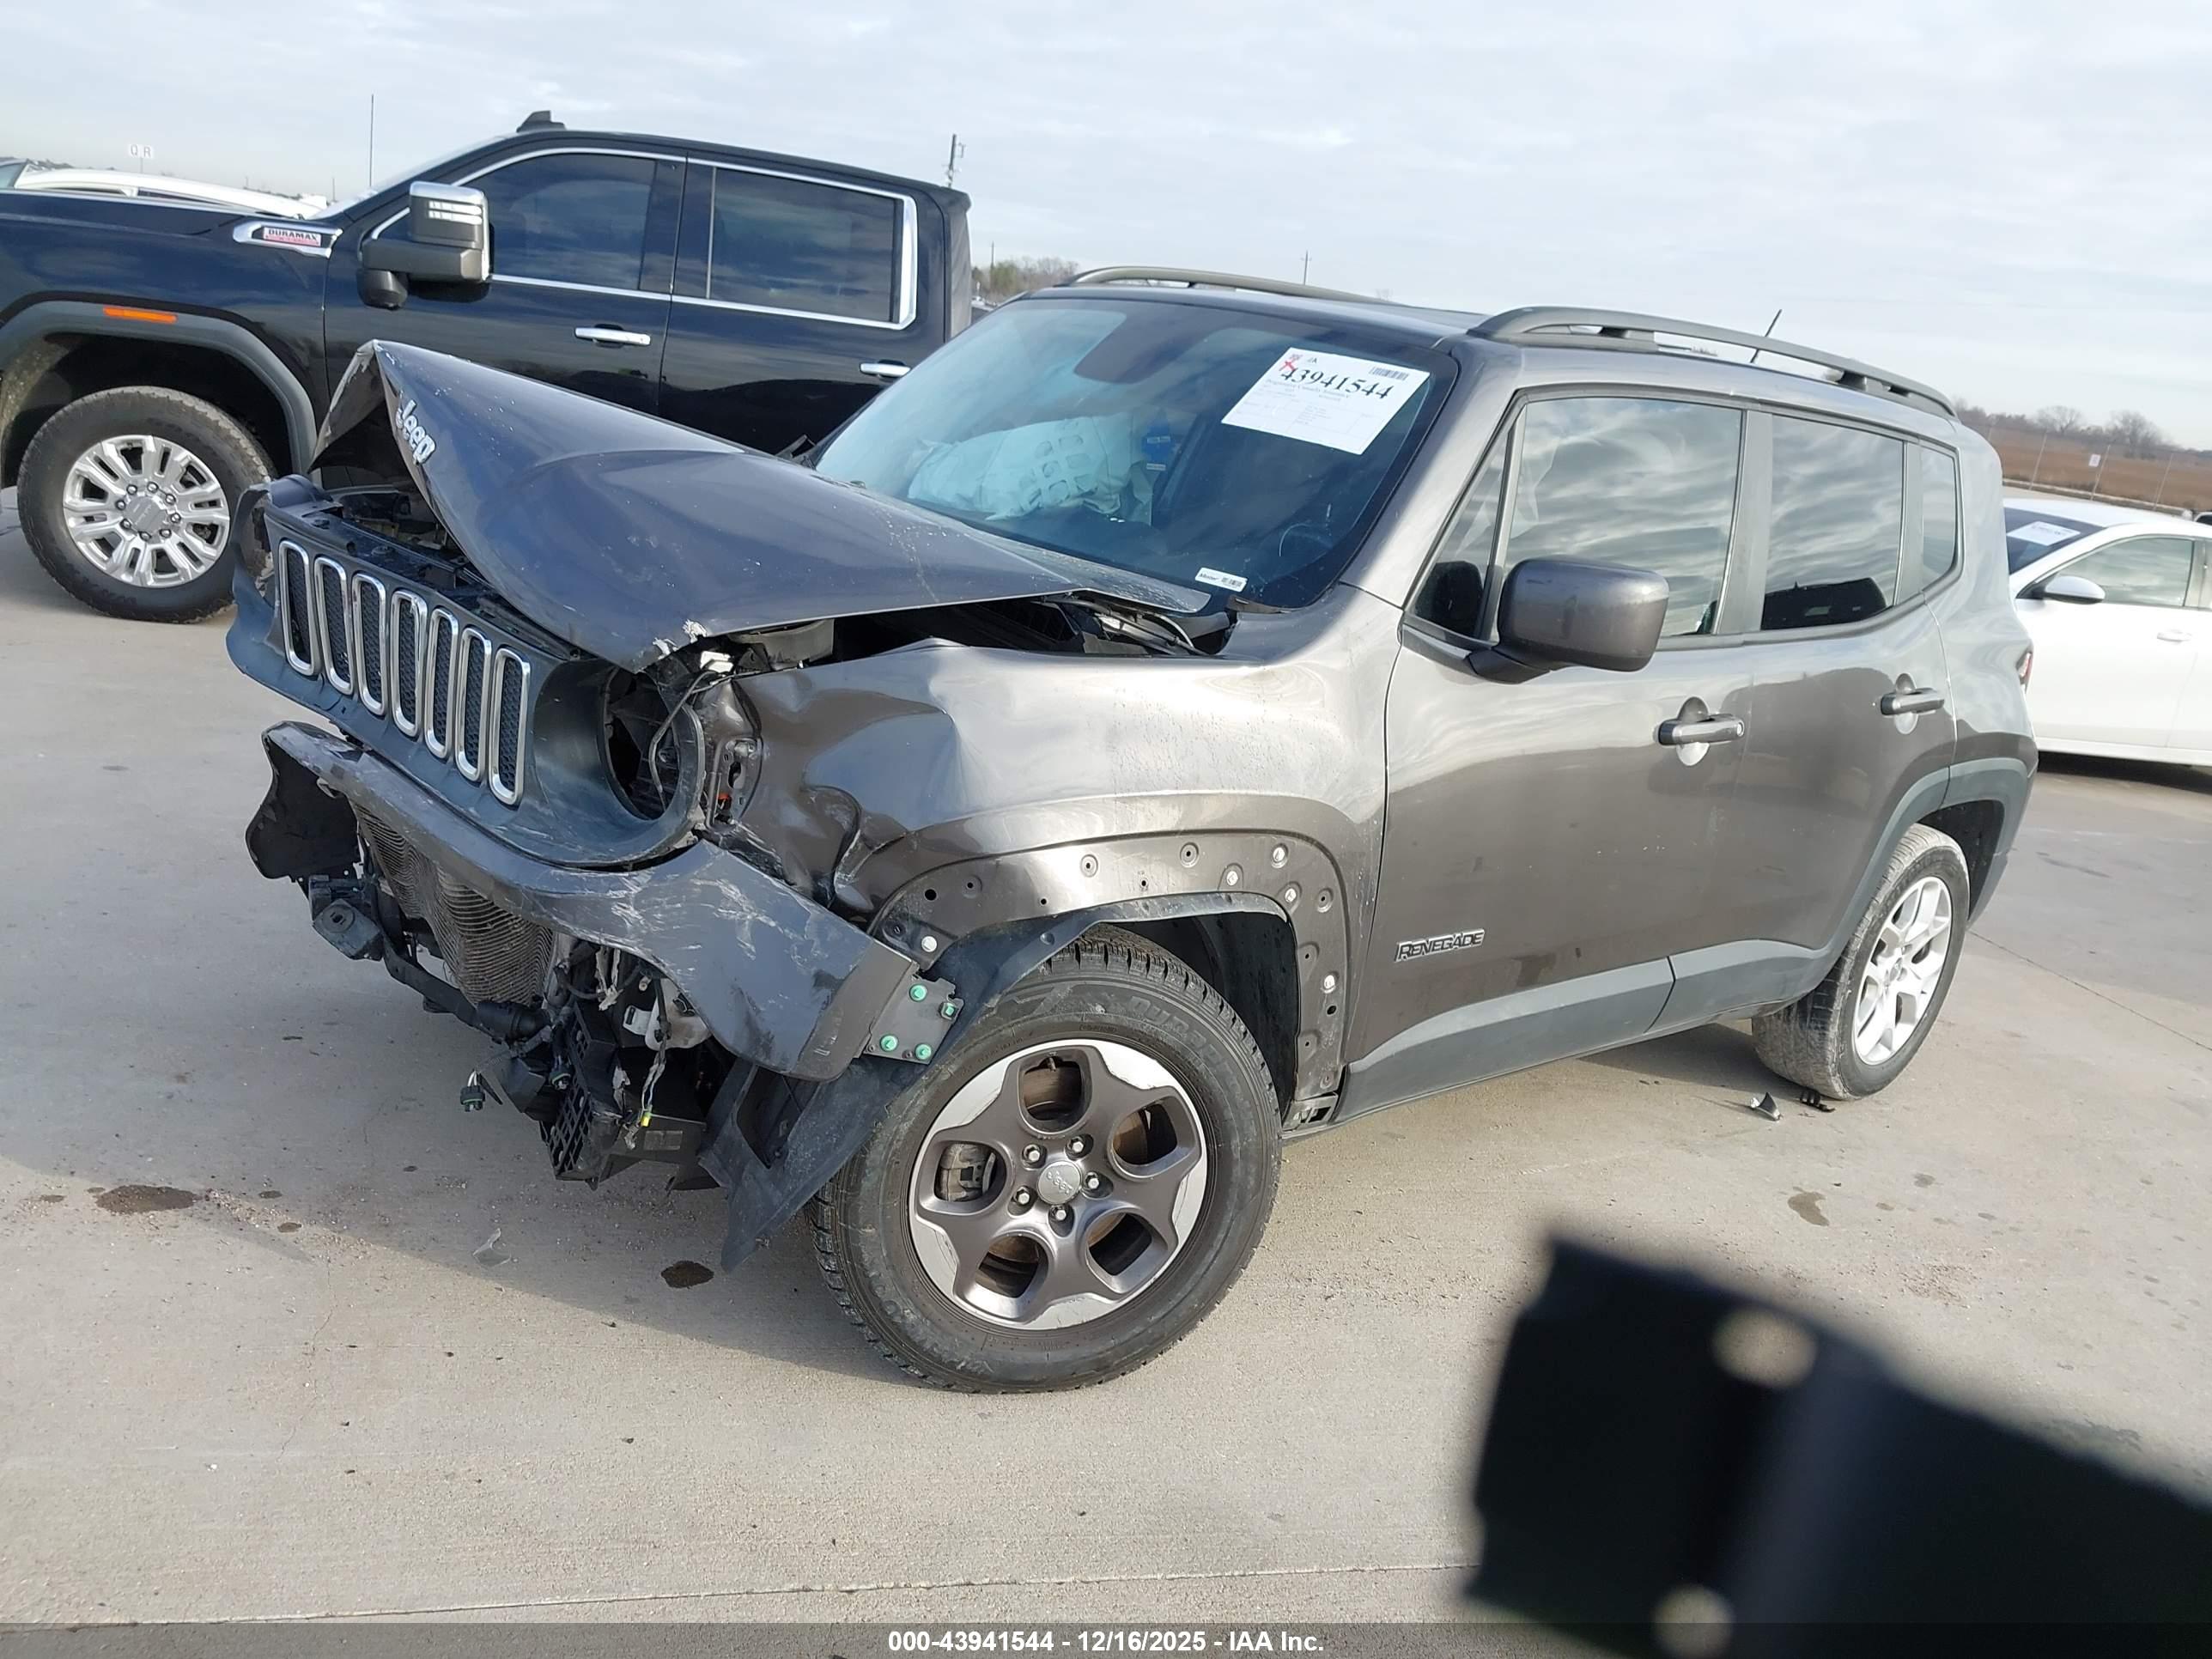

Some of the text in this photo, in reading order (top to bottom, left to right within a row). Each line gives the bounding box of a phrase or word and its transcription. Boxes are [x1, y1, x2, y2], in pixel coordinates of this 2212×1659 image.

[143, 145, 152, 158] R
[268, 228, 318, 241] DURAMAX
[1280, 368, 1395, 399] 43941544
[396, 399, 436, 465] Jeep
[1394, 928, 1485, 963] RENEGADE
